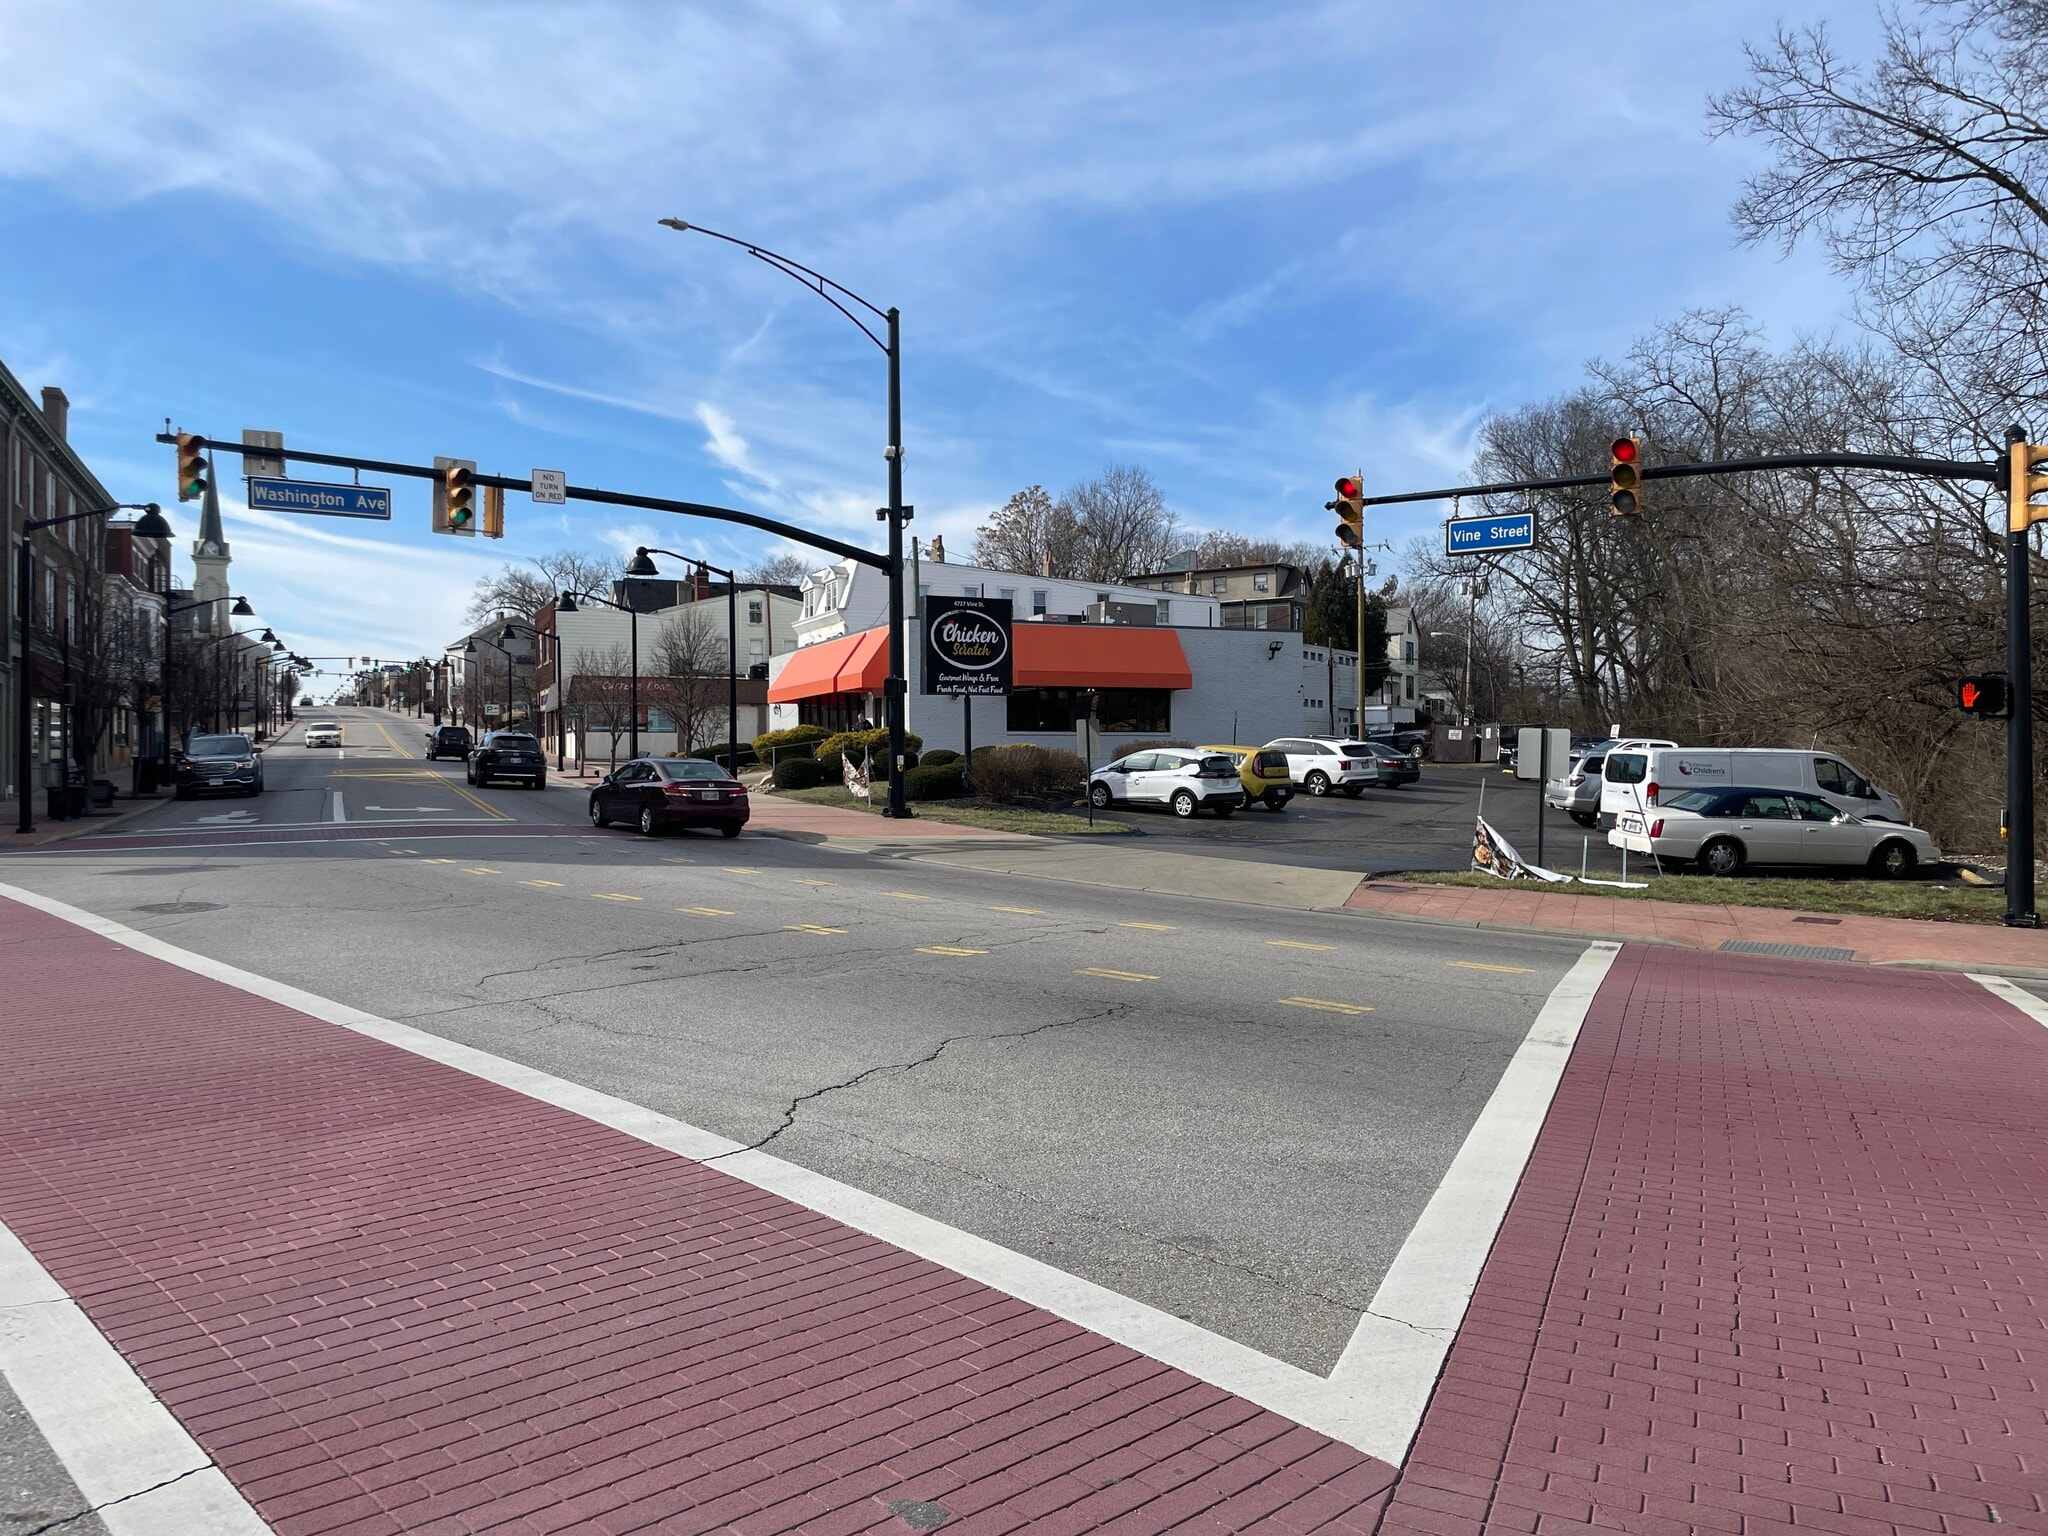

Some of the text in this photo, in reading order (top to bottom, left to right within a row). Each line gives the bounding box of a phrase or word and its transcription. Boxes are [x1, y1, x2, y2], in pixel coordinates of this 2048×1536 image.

[255, 486, 386, 510] Washington Ave
[548, 492, 563, 500] RED
[1453, 524, 1529, 542] Vine Street
[943, 623, 999, 643] Chicken
[952, 643, 991, 656] Scratch
[979, 673, 985, 682] &
[936, 684, 952, 693] Fresh
[990, 685, 1004, 693] Food
